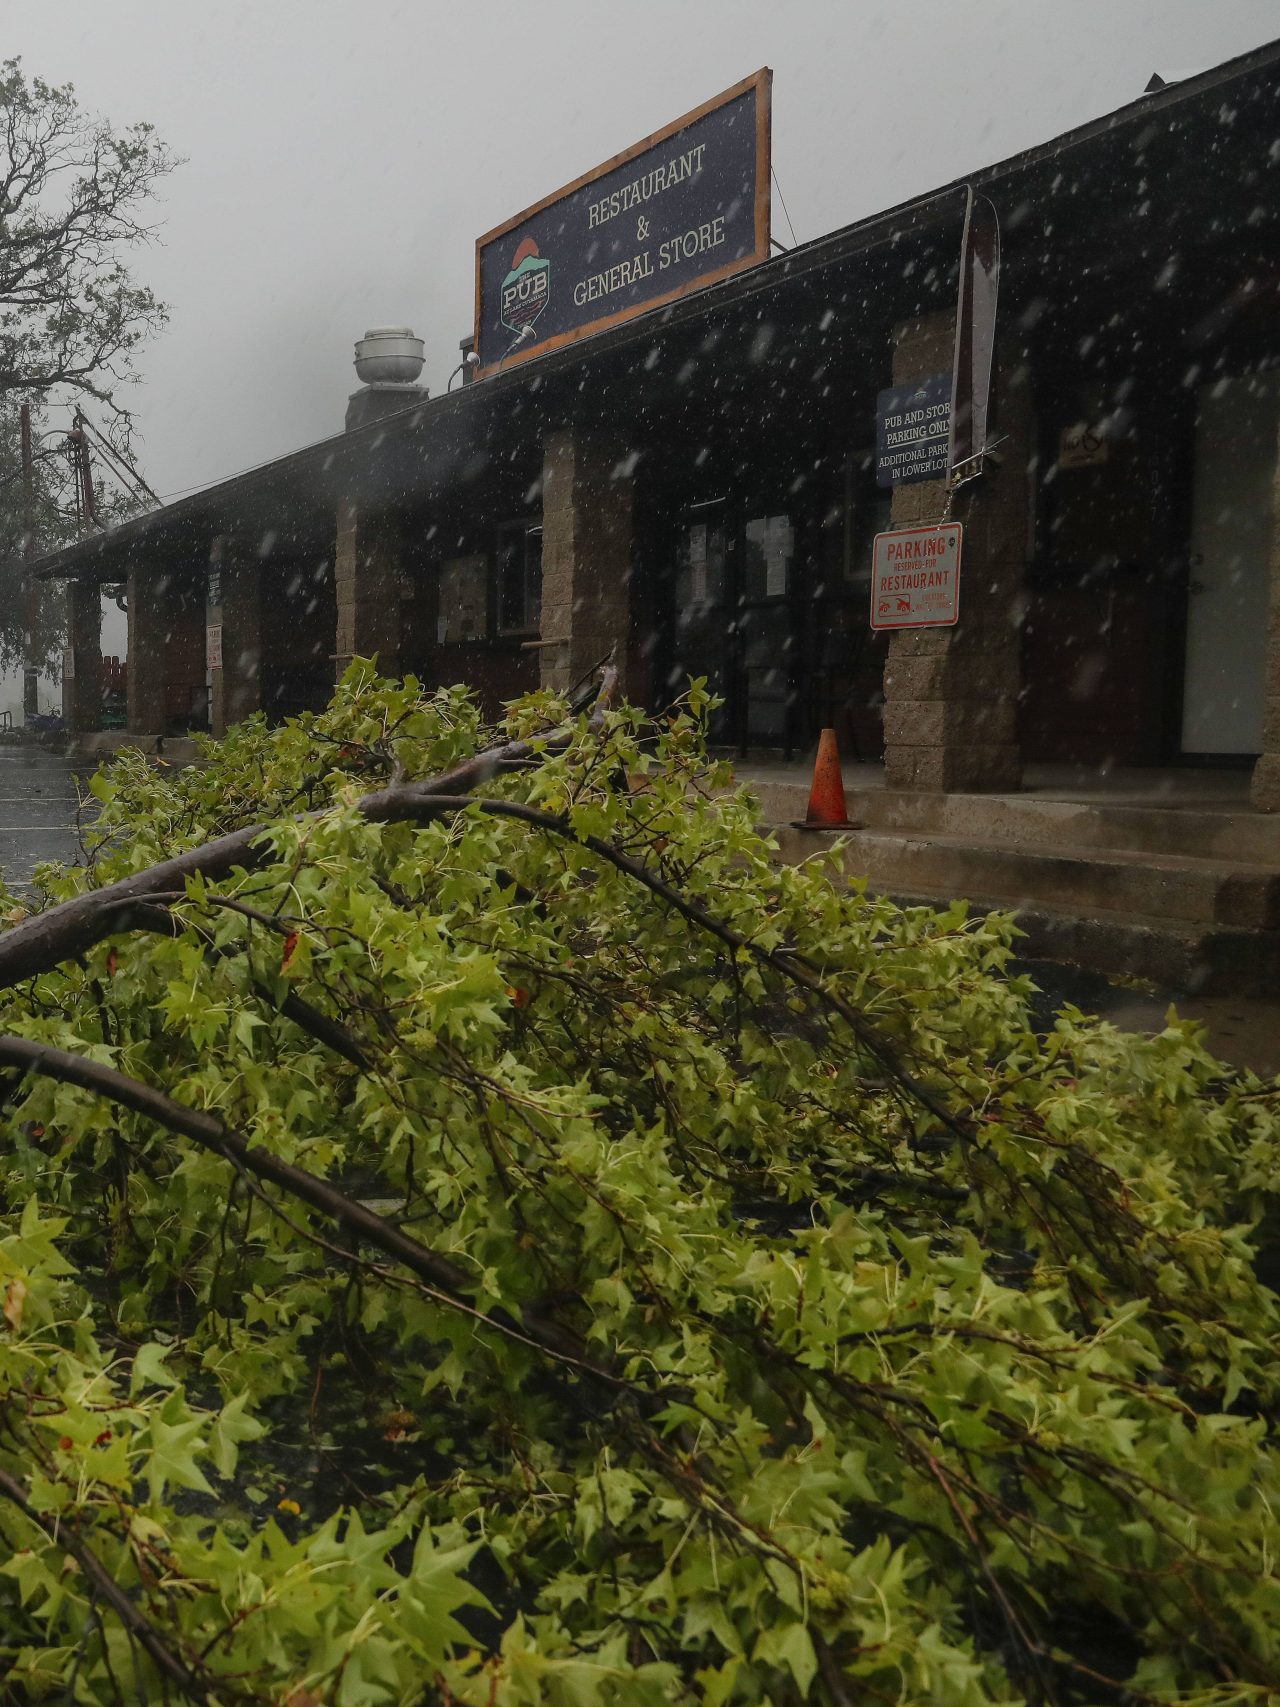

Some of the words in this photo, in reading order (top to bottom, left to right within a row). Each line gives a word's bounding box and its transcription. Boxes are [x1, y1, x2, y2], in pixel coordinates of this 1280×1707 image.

[588, 143, 706, 230] RESTAURANT
[636, 215, 650, 241] &
[573, 251, 654, 307] GENERAL
[659, 215, 725, 270] STORE
[503, 271, 547, 310] PUB
[884, 415, 902, 430] PUB
[903, 409, 925, 425] AND
[926, 402, 951, 419] STOR
[886, 425, 927, 445] PARKING
[878, 448, 927, 468] ADDITIONAL
[928, 443, 949, 457] PARK
[892, 468, 900, 479] IN
[902, 460, 931, 477] LOWER
[932, 457, 948, 471] LOT
[887, 537, 946, 561] PARKING
[880, 571, 950, 592] RESTAURANT
